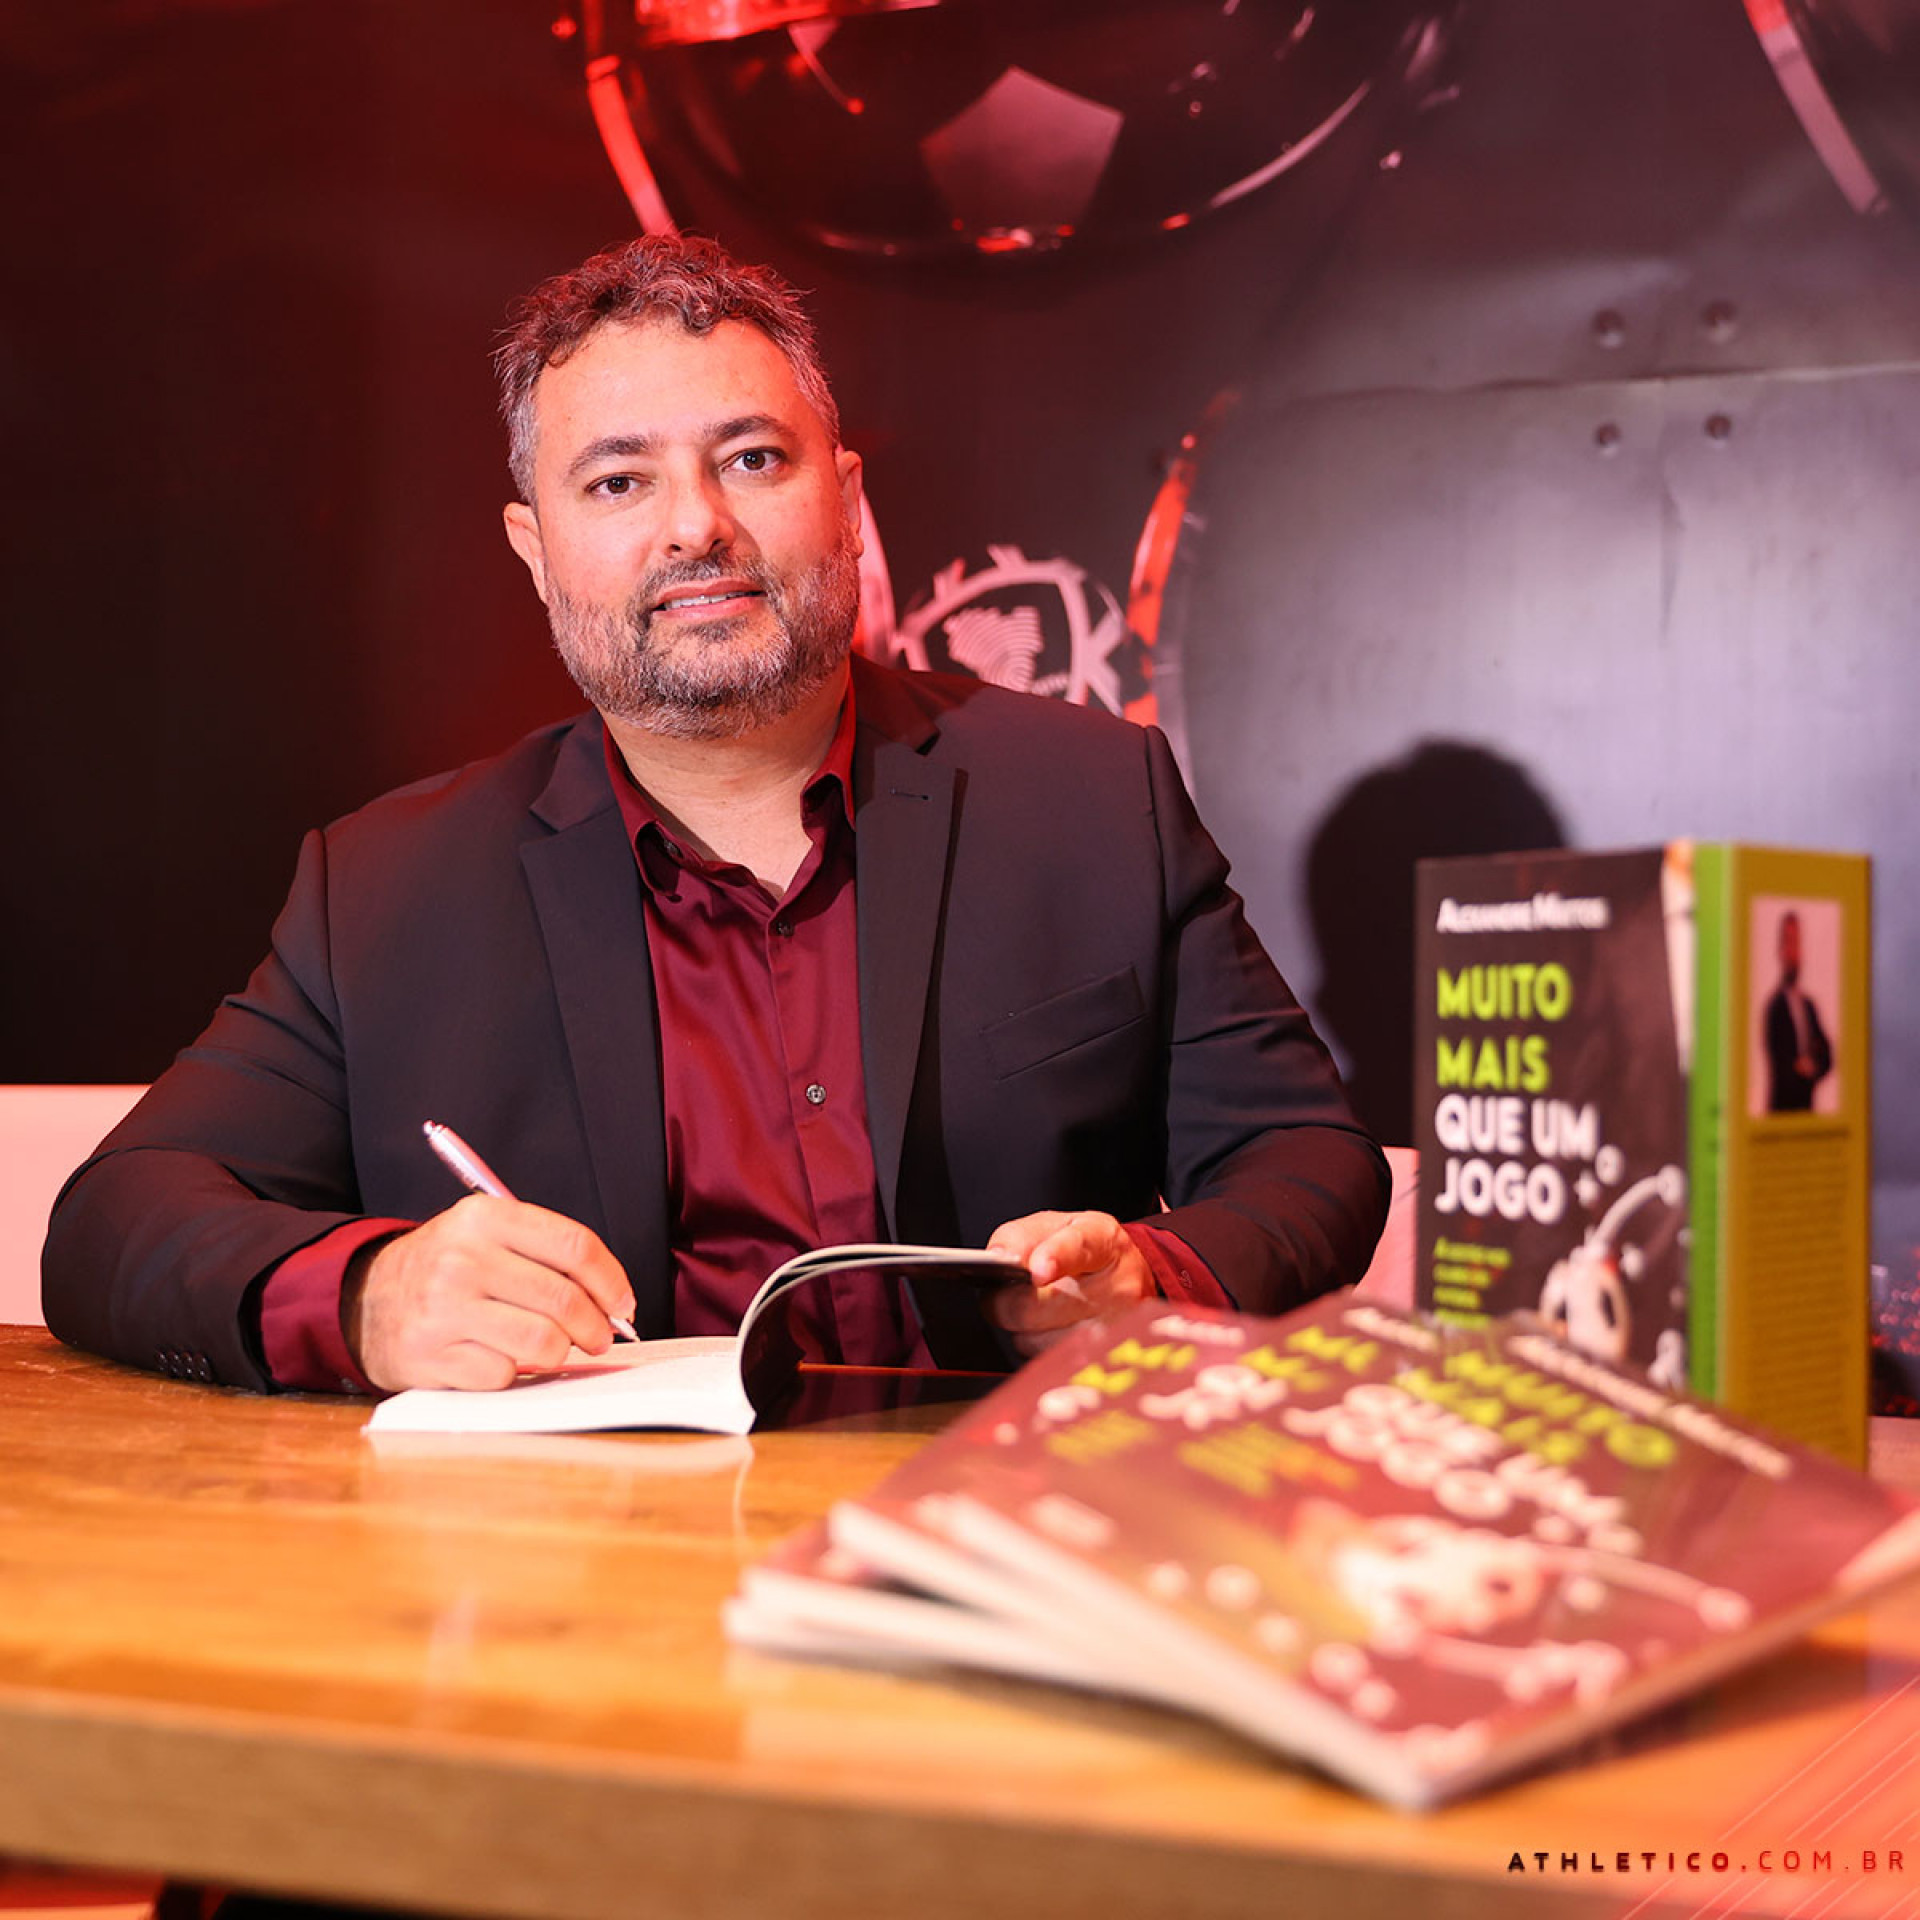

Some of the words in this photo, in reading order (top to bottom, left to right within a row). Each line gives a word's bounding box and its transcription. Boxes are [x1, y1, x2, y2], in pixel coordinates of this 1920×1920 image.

[1436, 962, 1571, 1020] MUITO
[1436, 1035, 1549, 1091] MAIS
[1435, 1094, 1525, 1153] QUE
[1531, 1100, 1599, 1160] UM
[1434, 1158, 1565, 1224] JOGO
